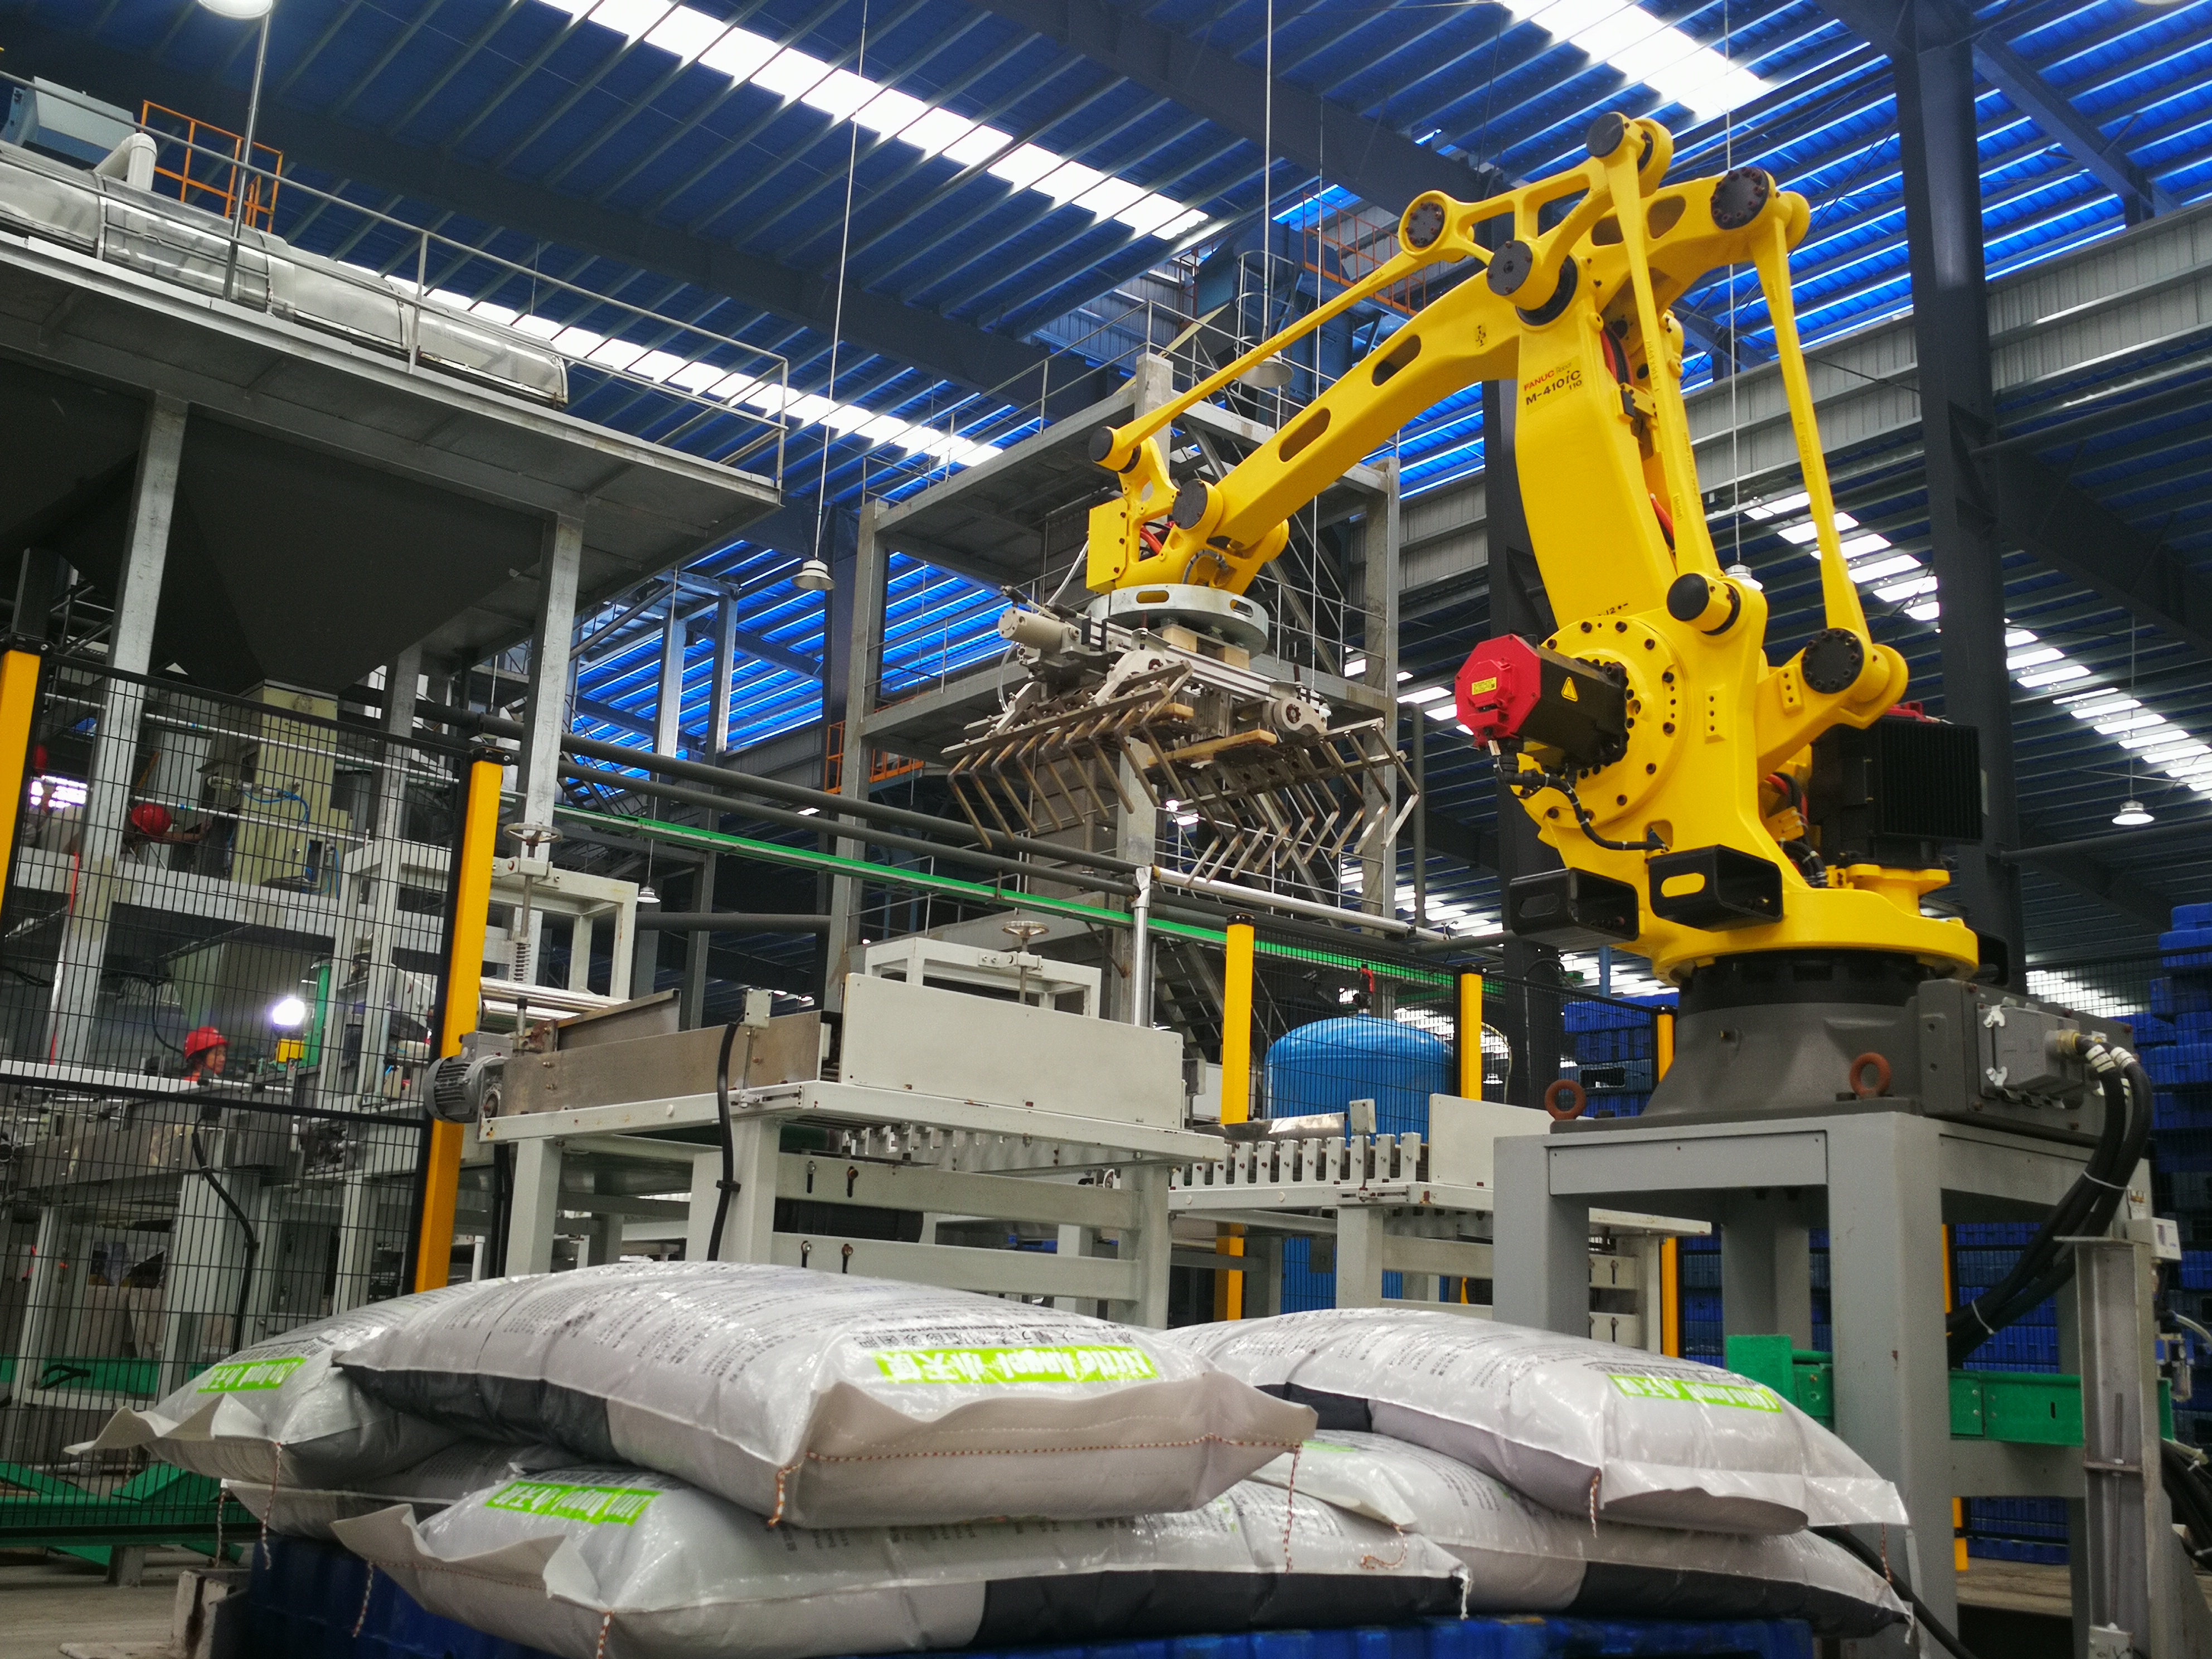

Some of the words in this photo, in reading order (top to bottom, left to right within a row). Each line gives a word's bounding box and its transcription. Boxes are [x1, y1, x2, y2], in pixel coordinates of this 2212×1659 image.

[1524, 370, 1555, 391] FANUC
[1569, 380, 1582, 390] 110
[879, 1352, 984, 1382] 小天使
[1077, 1350, 1151, 1375] Little
